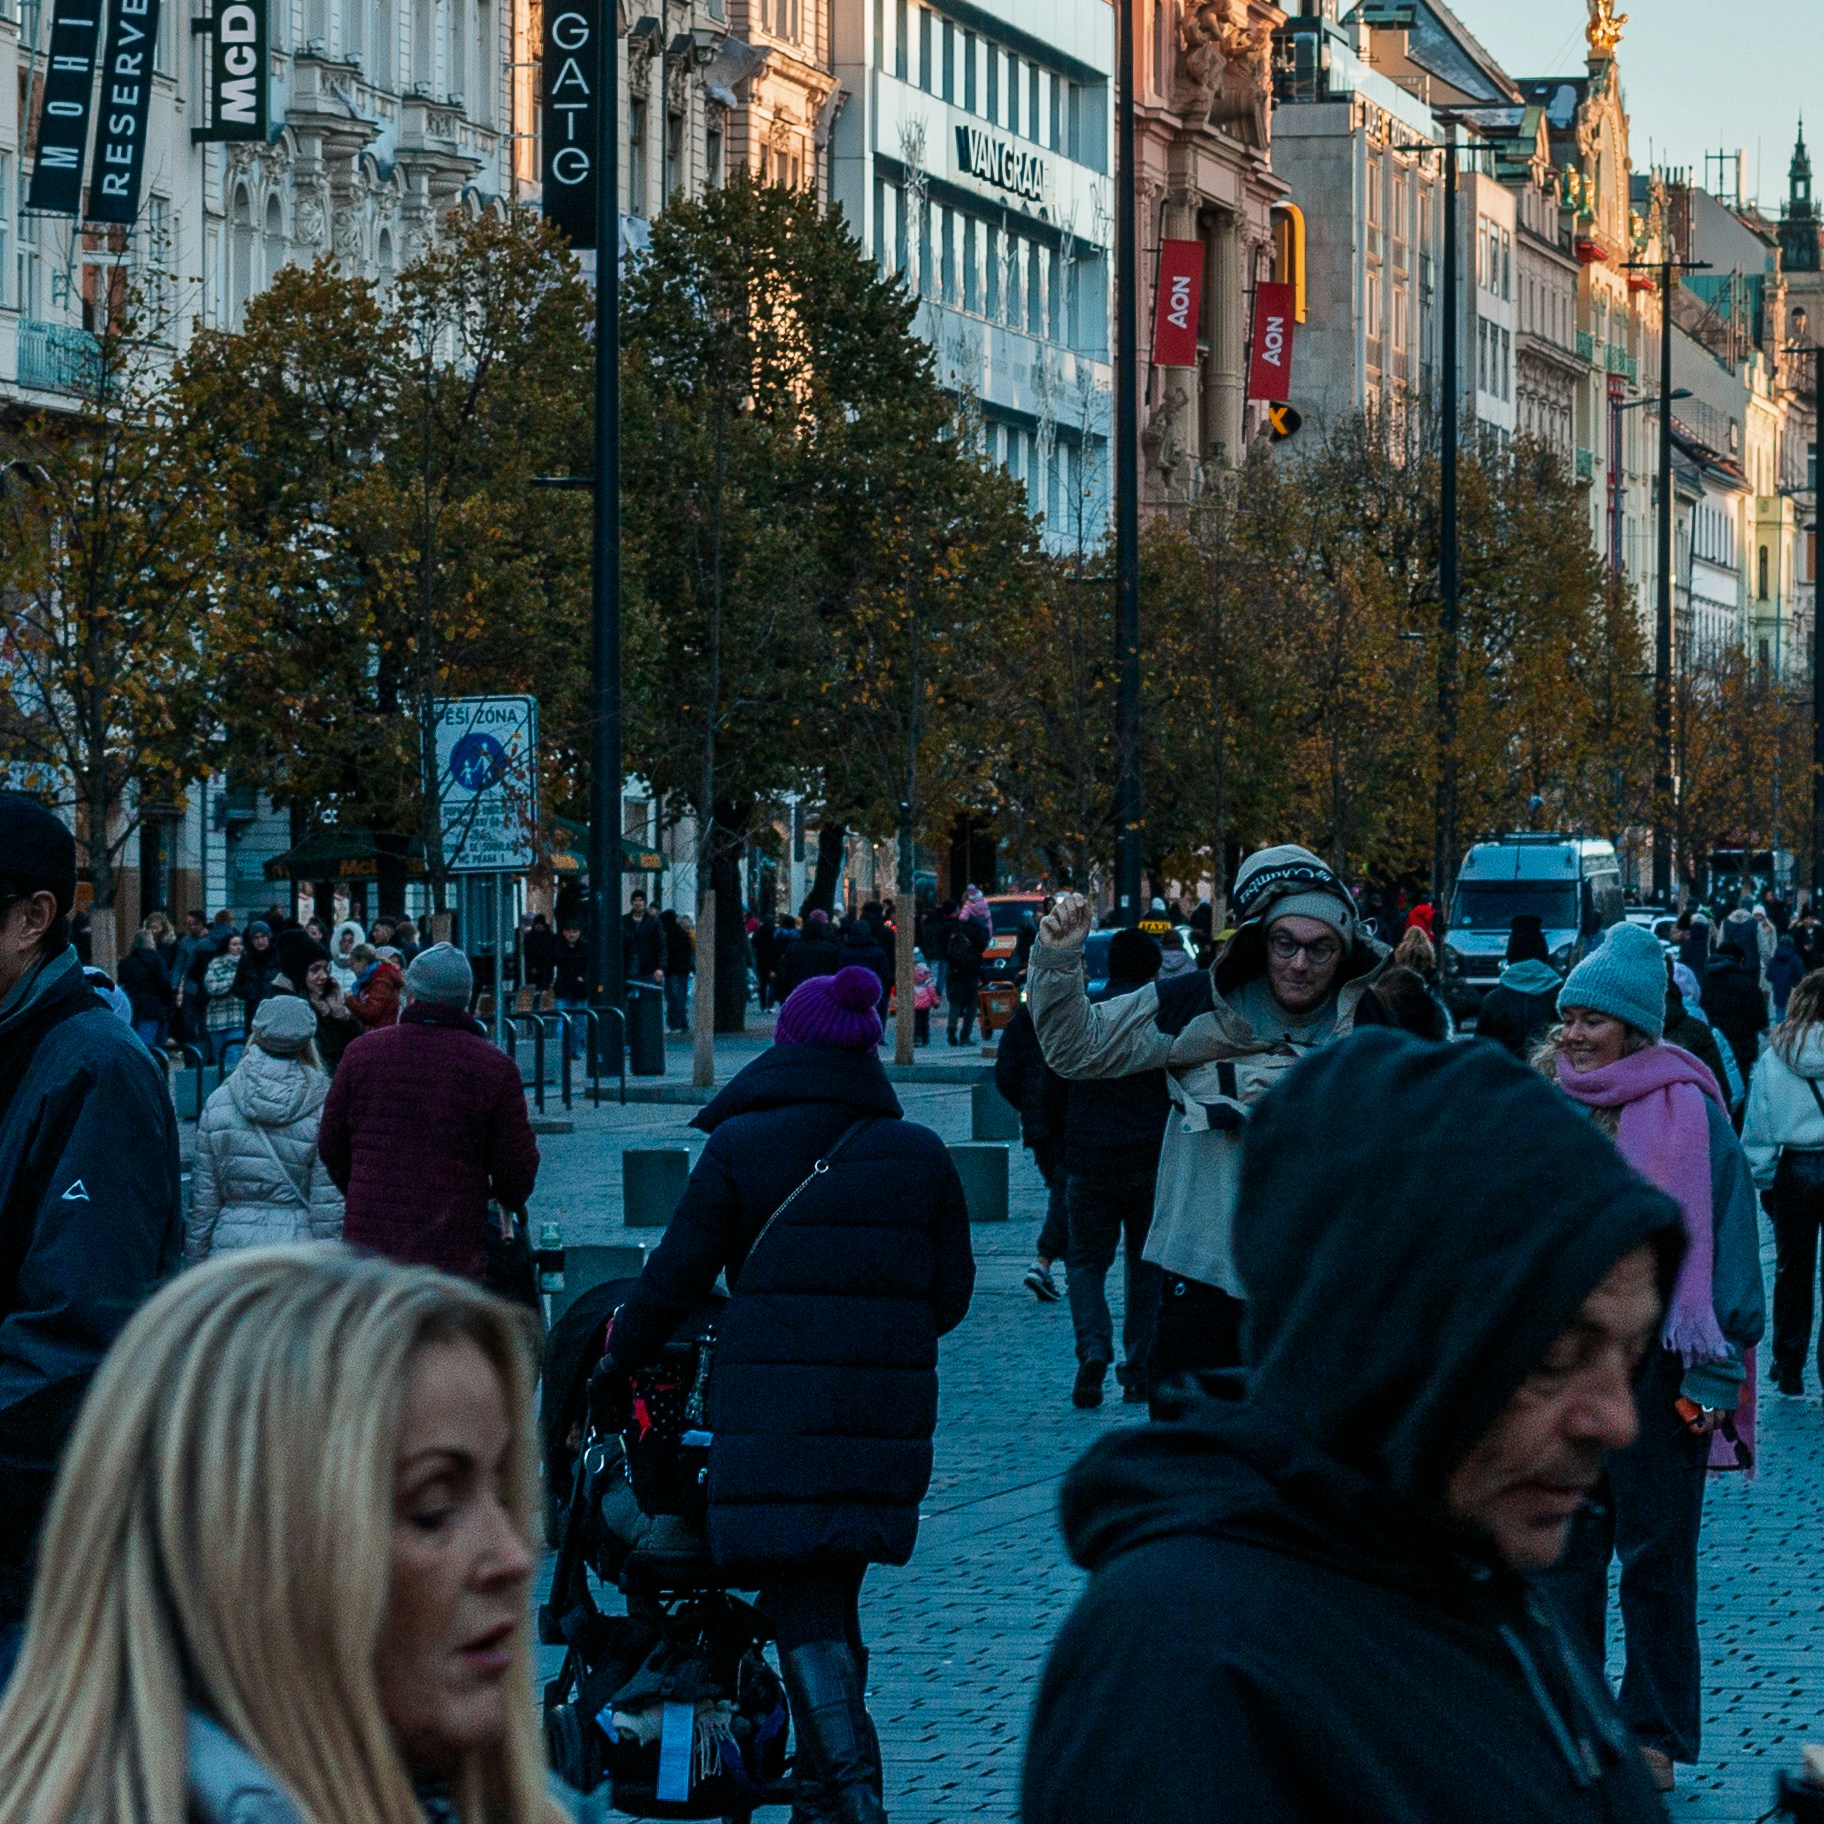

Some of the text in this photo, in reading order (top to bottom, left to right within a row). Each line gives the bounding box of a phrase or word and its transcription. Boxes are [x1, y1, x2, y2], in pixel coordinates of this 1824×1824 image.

[964, 127, 1000, 182] VAN
[1166, 274, 1191, 329] AON
[1261, 315, 1284, 367] AON
[476, 706, 519, 725] ZÓNA
